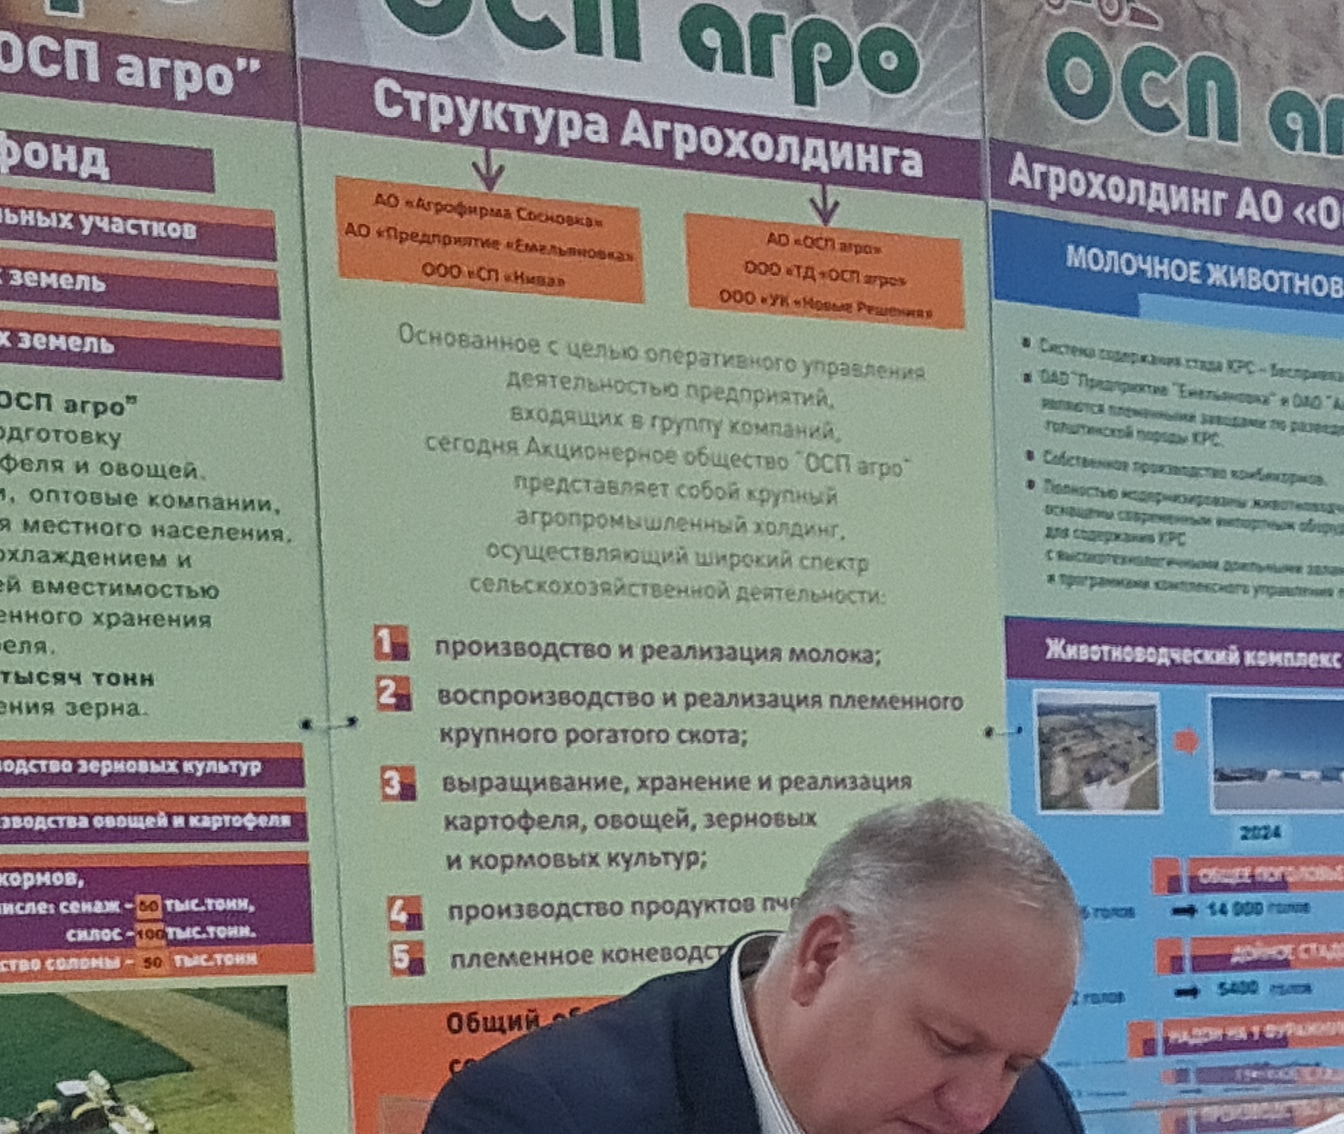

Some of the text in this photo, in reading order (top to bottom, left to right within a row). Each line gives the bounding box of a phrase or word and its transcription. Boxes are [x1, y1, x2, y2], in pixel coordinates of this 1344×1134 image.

[678, 2, 922, 108] агро
[1044, 26, 1241, 145] ОСП
[373, 77, 924, 179] Структура Агрохолдинга
[1009, 151, 1229, 218] Агрохолдинг
[1235, 189, 1284, 223] АО
[374, 193, 400, 208] АО
[404, 196, 512, 218] «Агрофирма
[0, 208, 198, 240] ьных участков
[345, 221, 370, 238] АО
[376, 226, 500, 251] «Предприятие
[767, 232, 789, 246] АО
[422, 262, 462, 279] ООО
[744, 260, 781, 275] ООО
[1065, 244, 1201, 285] МОЛОЧНОЕ
[9, 269, 107, 292] земель
[719, 288, 756, 304] ООО
[18, 332, 116, 354] земель
[399, 322, 926, 382] Основанное с целью оперативного управления
[506, 371, 834, 410] деятельностью предприятий,
[511, 405, 842, 444] входящих в группу компаний,
[75, 459, 89, 474] и
[426, 435, 518, 457] сегодня
[527, 436, 676, 467] Акционерное
[684, 445, 789, 472] общество
[29, 488, 138, 508] оптовые
[148, 494, 281, 515] компании,
[514, 473, 839, 508] представляет собой крупный
[23, 518, 142, 537] местного
[151, 523, 292, 543] населения.
[516, 507, 748, 537] агропромышленный
[177, 552, 192, 568] и
[486, 540, 870, 577] осуществляющий широкий спектр
[32, 579, 220, 600] вместимостью
[470, 575, 887, 606] сельскохозяйственной деятельности:
[92, 611, 213, 630] хранения
[0, 638, 55, 655] еля.
[377, 628, 881, 667] 1 производство и реализация молока;
[1046, 636, 1240, 668] Животноводческий
[1244, 649, 1342, 671] комплекс
[1, 670, 155, 687] тысяч тонн
[378, 679, 964, 713] 2 воспроизводство и реализация племенного
[65, 701, 149, 719] зерна.
[440, 725, 748, 748] крупного рогатого скота;
[0, 759, 262, 776] одство зерновых культур
[382, 770, 912, 796] 3 выращивание, хранение и реализация
[0, 810, 291, 831] зводства овощей и картофеля
[444, 805, 817, 834] картофеля, овощей, зерновых
[1240, 825, 1283, 841] 2024
[447, 848, 708, 875] и кормовых культур;
[0, 900, 54, 915] исле:
[59, 900, 120, 915] сенаж
[388, 899, 407, 925] 4
[448, 898, 624, 923] производство
[630, 897, 756, 922] продуктов
[66, 926, 123, 942] силос
[137, 928, 164, 941] 100
[45, 955, 121, 972] соломы
[143, 956, 163, 970] 50
[173, 952, 258, 968] тыс.тонн
[391, 944, 411, 970] 5
[450, 944, 594, 971] племенное
[447, 1009, 540, 1034] Общий
